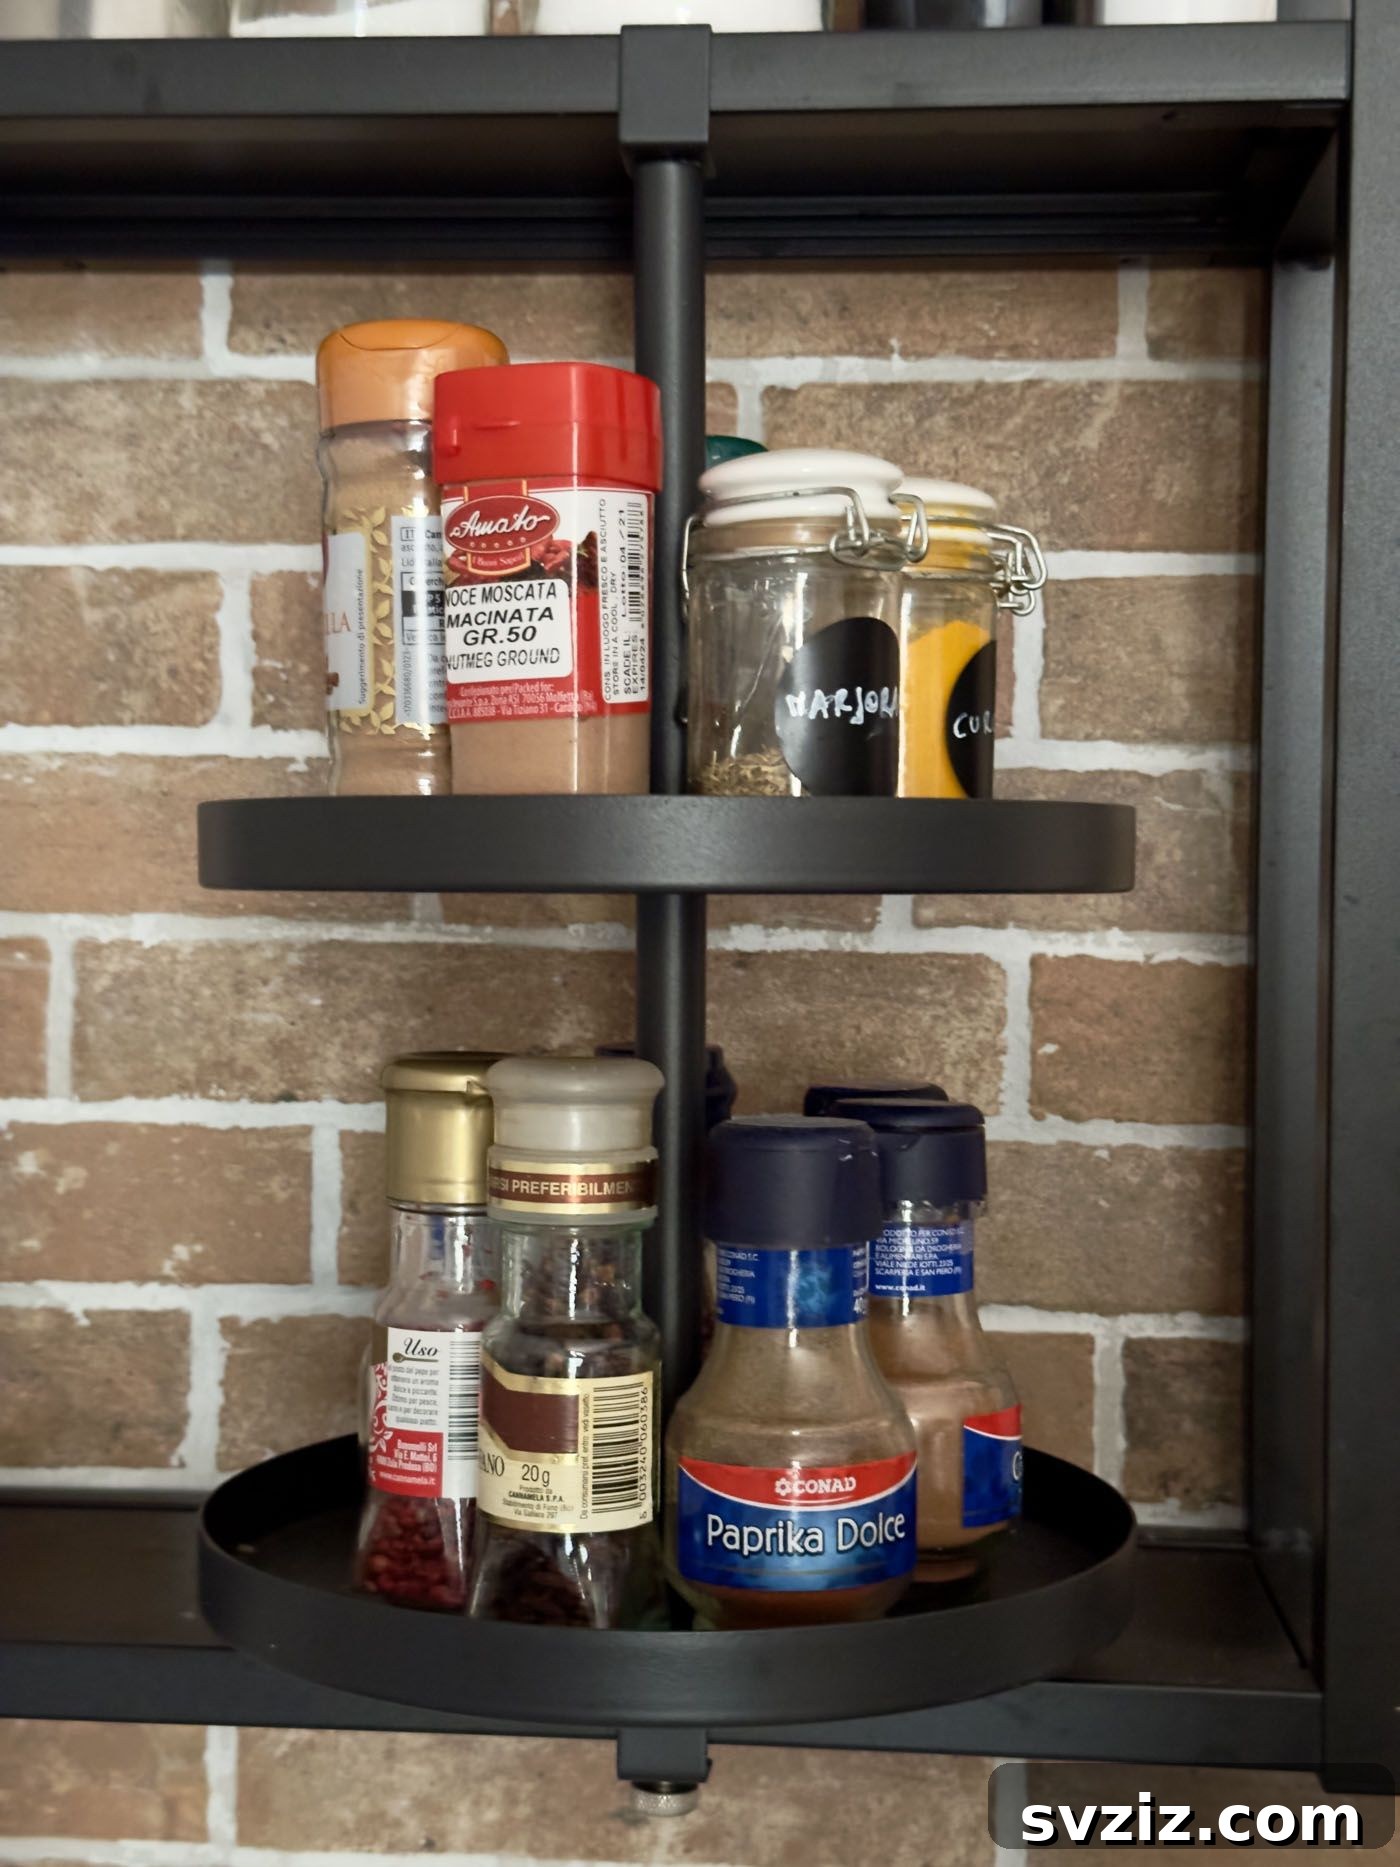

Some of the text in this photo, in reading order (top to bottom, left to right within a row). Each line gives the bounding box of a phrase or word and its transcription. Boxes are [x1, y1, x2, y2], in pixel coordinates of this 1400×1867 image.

[449, 504, 550, 538] Amato
[599, 498, 607, 552] ASCIUTTO
[356, 568, 366, 630] presentazione
[481, 582, 557, 604] MOSCATA
[600, 566, 608, 610] FRESCO
[446, 607, 554, 628] MACINATA
[610, 604, 618, 633] COOL
[463, 625, 537, 646] GR.50
[602, 612, 610, 651] LUOGO
[497, 647, 560, 666] GROUND
[603, 654, 610, 665] IN
[611, 646, 618, 657] IN
[623, 650, 631, 695] SCADE
[921, 1268, 935, 1276] SAN
[404, 1336, 438, 1356] Uso
[639, 1387, 648, 1441] 060386
[521, 1463, 551, 1488] 20 g
[639, 1447, 648, 1501] 003240
[793, 1476, 856, 1495] CONAD
[579, 1510, 589, 1520] Da
[706, 1512, 905, 1556] Paprika Dolce
